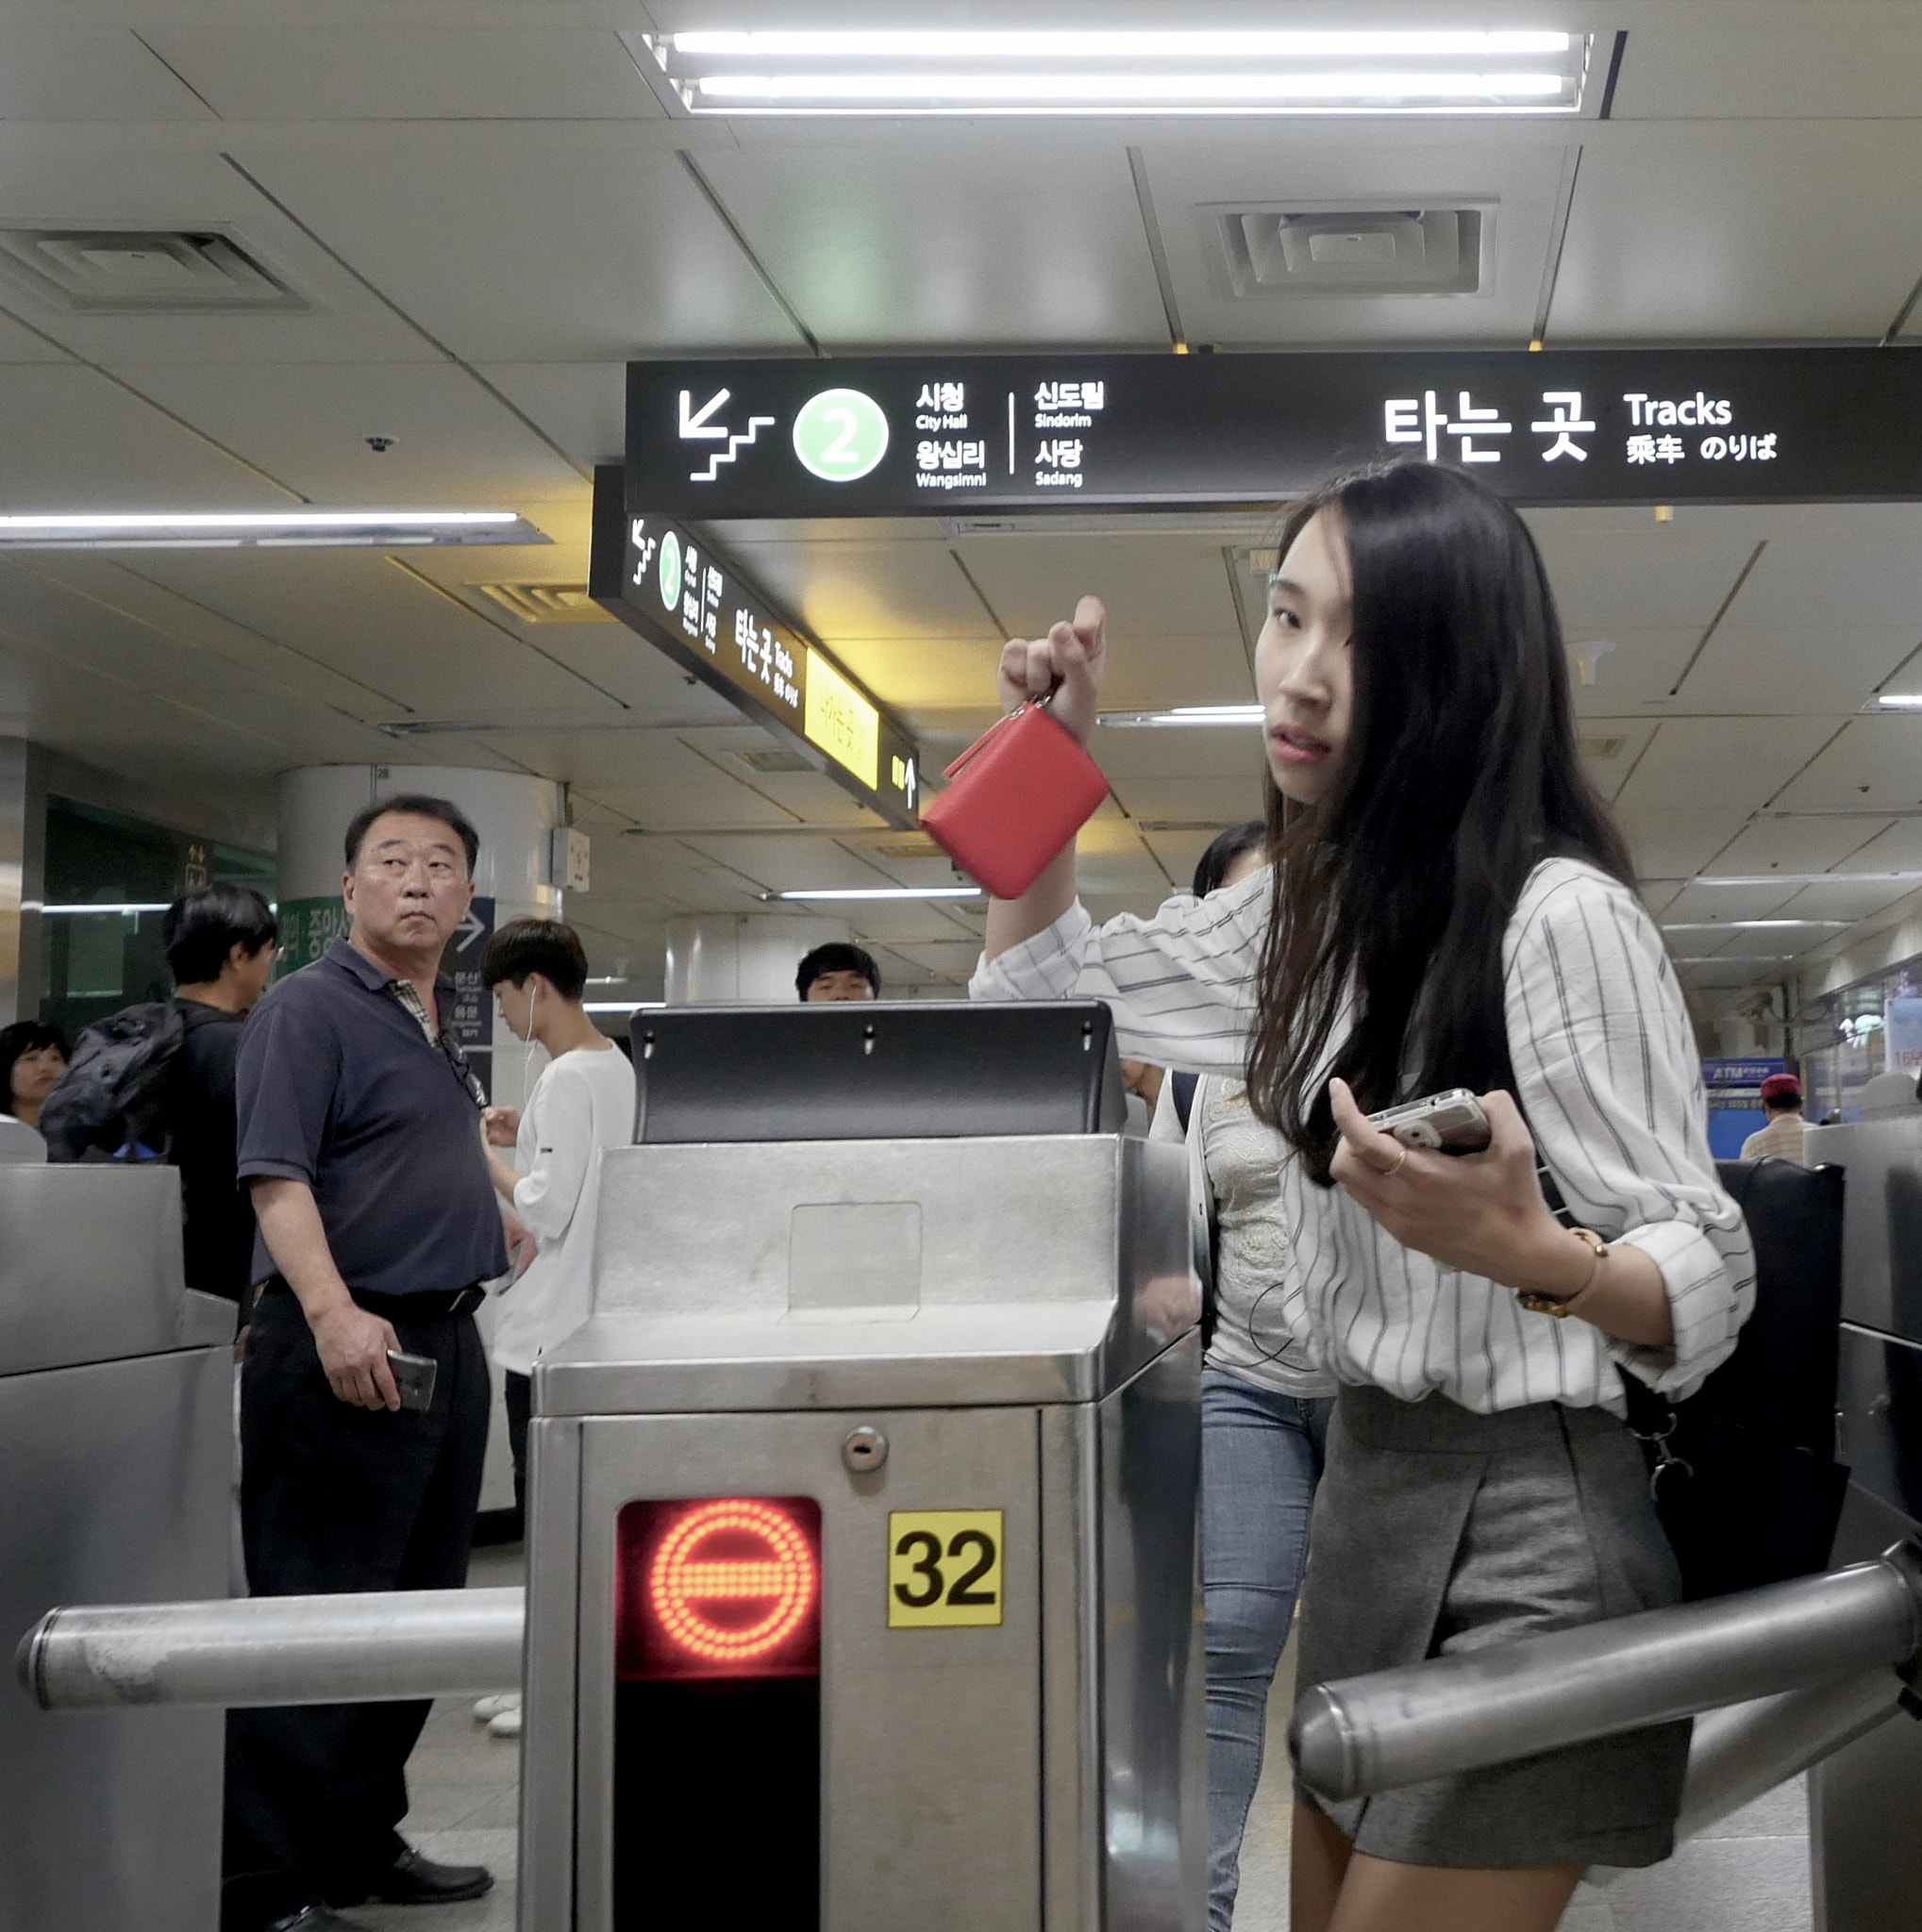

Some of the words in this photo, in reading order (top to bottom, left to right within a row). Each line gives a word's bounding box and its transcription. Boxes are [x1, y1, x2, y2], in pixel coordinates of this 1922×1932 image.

[915, 382, 964, 412] 시청
[1033, 380, 1105, 411] 신도림
[1622, 391, 1733, 426] Tracks
[915, 414, 942, 433] City
[943, 413, 968, 429] Hall
[1034, 412, 1093, 428] Sindorim
[1384, 390, 1513, 462] 타는
[1530, 391, 1596, 462] 곳
[820, 408, 860, 464] 2
[1699, 432, 1778, 461] のりば
[915, 440, 986, 471] 왕십리
[1034, 438, 1084, 469] 사당
[915, 472, 987, 491] Wangsimni
[1035, 470, 1083, 489] Sadang
[894, 1529, 996, 1607] 32
